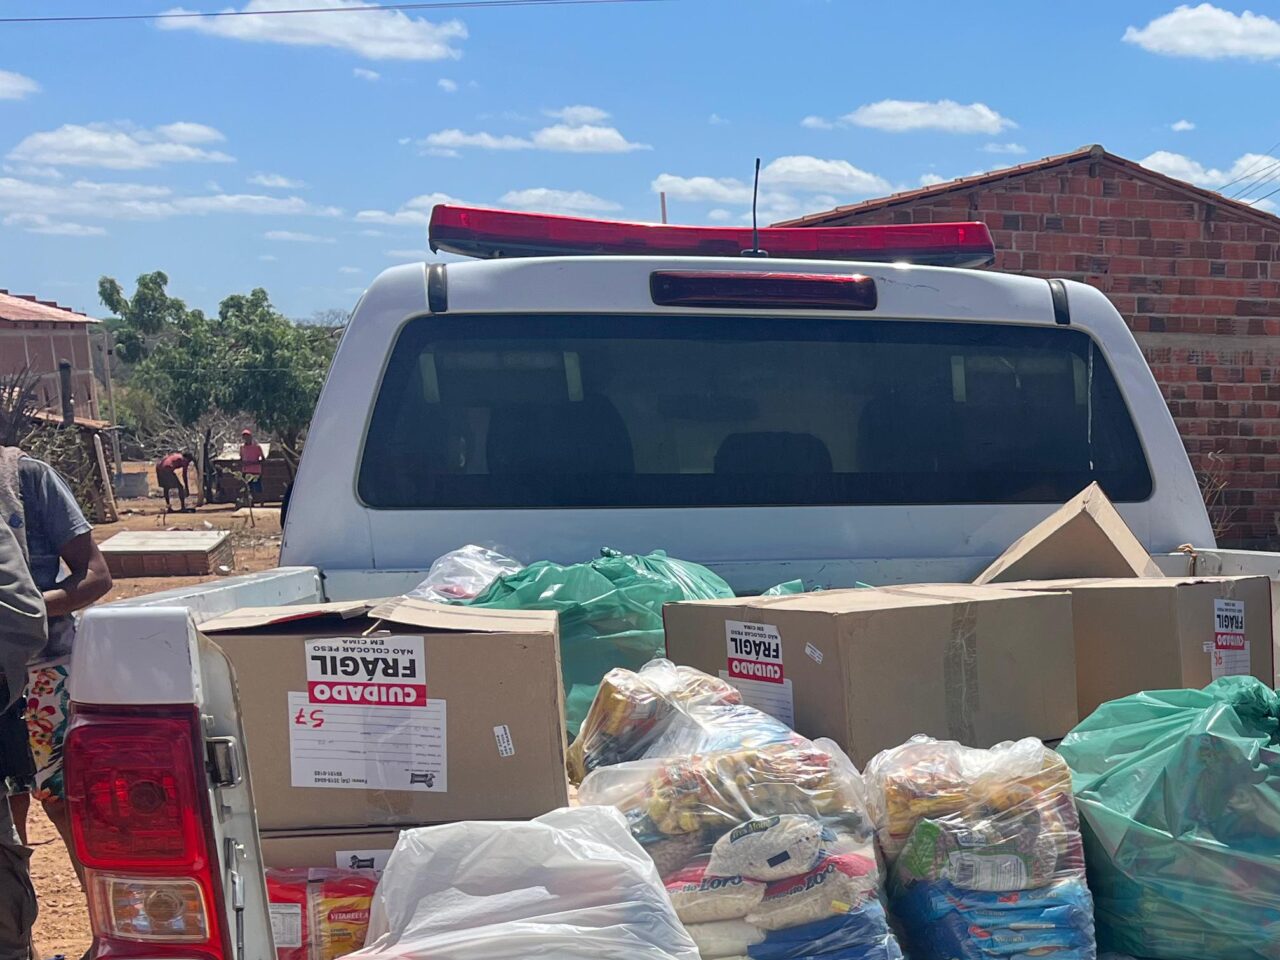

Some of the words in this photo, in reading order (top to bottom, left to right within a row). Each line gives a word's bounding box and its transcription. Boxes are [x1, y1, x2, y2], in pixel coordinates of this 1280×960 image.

[312, 645, 340, 653] PESO
[341, 646, 390, 655] COLOCAR
[392, 648, 414, 656] NÃO
[730, 637, 780, 660] FRÁGIL
[310, 655, 417, 681] FRÁGIL
[732, 660, 781, 679] CUIDADO
[313, 684, 417, 703] CUIDADO
[330, 911, 369, 920] VITARELLA
